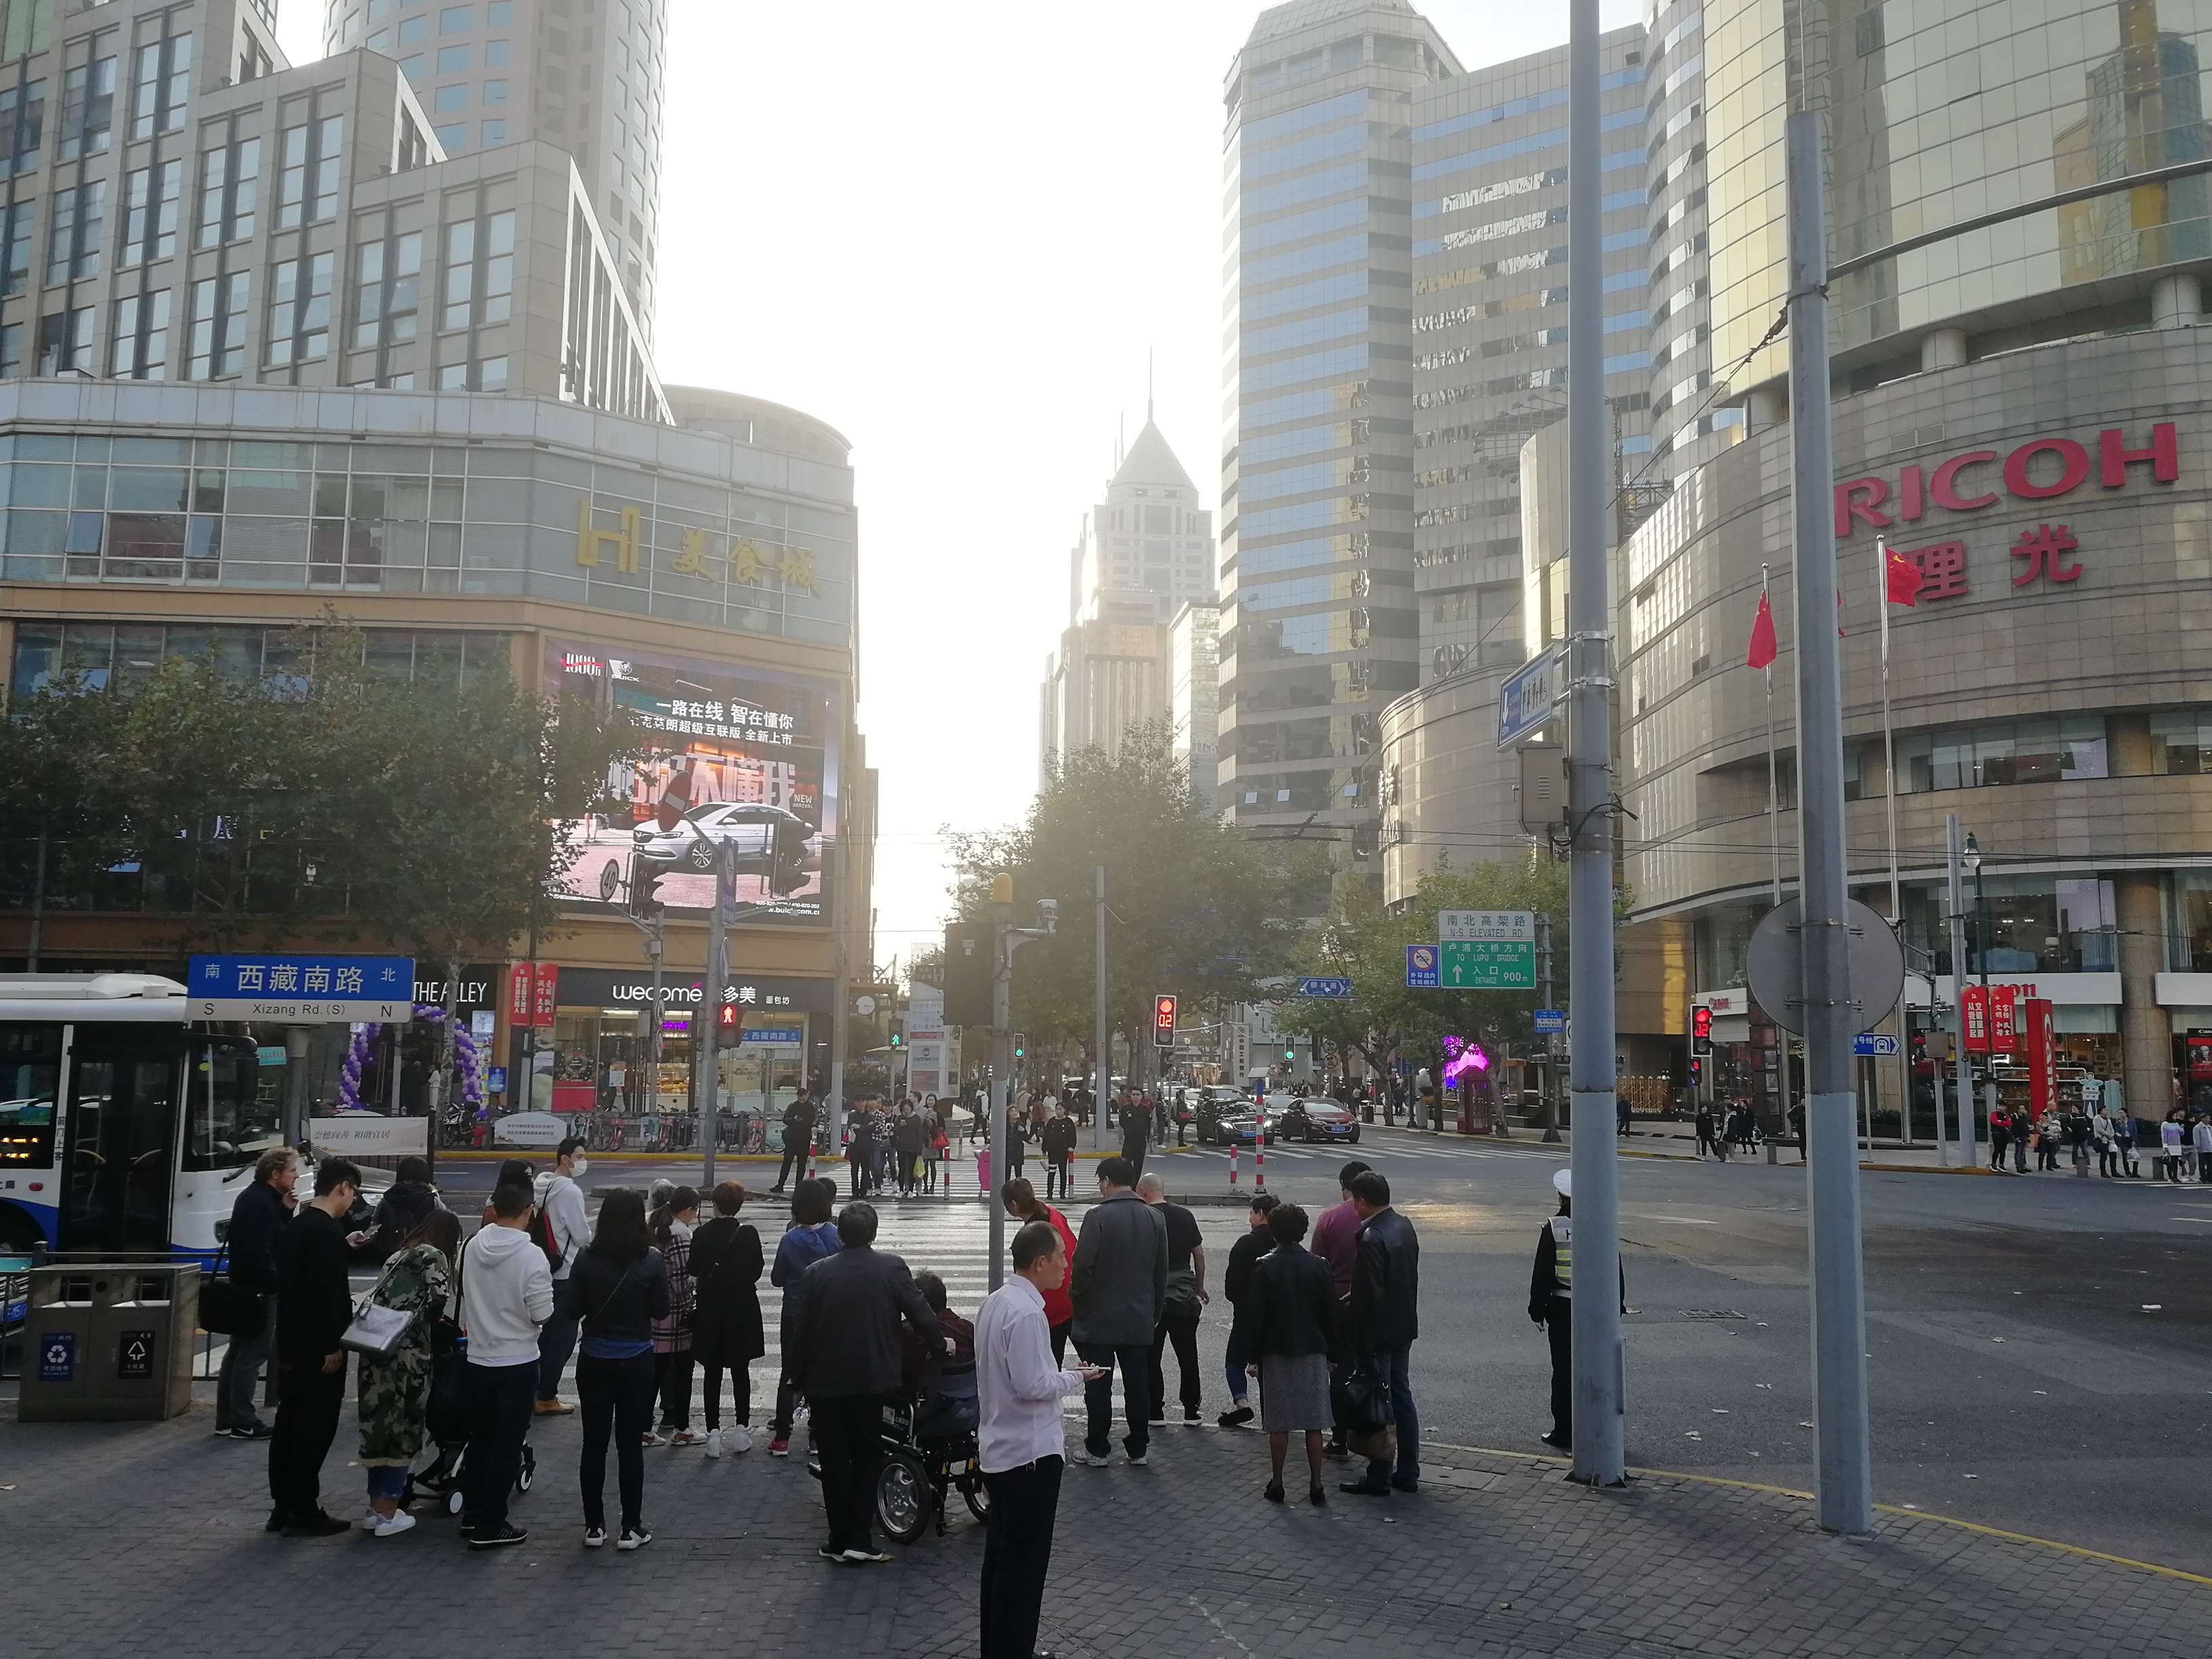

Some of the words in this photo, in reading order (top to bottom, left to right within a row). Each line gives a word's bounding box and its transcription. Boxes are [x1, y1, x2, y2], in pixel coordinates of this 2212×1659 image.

[1835, 422, 2179, 537] RICOH
[1900, 524, 2083, 601] 理光
[611, 674, 640, 682] BUICK
[656, 699, 724, 722] 一路在线
[731, 703, 794, 730] 智在懂你
[628, 716, 741, 739] 克英朗超级互联版
[745, 729, 794, 745] 全新上市
[794, 794, 813, 804] NEW
[604, 870, 616, 890] 40
[1447, 914, 1525, 926] 南北高架路
[1450, 928, 1464, 937] N-S
[1469, 928, 1505, 938] ELEVATED
[1512, 928, 1523, 938] RD
[1448, 943, 1528, 953] 卢浦大桥方向
[205, 963, 221, 979] 南
[381, 966, 396, 982] 北
[1472, 966, 1499, 975] 入口
[237, 964, 365, 994] 西藏南路
[413, 981, 438, 1002] THE
[440, 982, 487, 1002] ALEY
[720, 985, 756, 1004] 多美
[765, 996, 790, 1005] 面包坊
[203, 1003, 214, 1016] S
[252, 1004, 295, 1017] Xizang
[380, 1005, 392, 1017] N
[752, 1031, 787, 1040] 西藏南路
[2044, 1012, 2055, 1104] Cano
[353, 1130, 390, 1140] 和谐宜居
